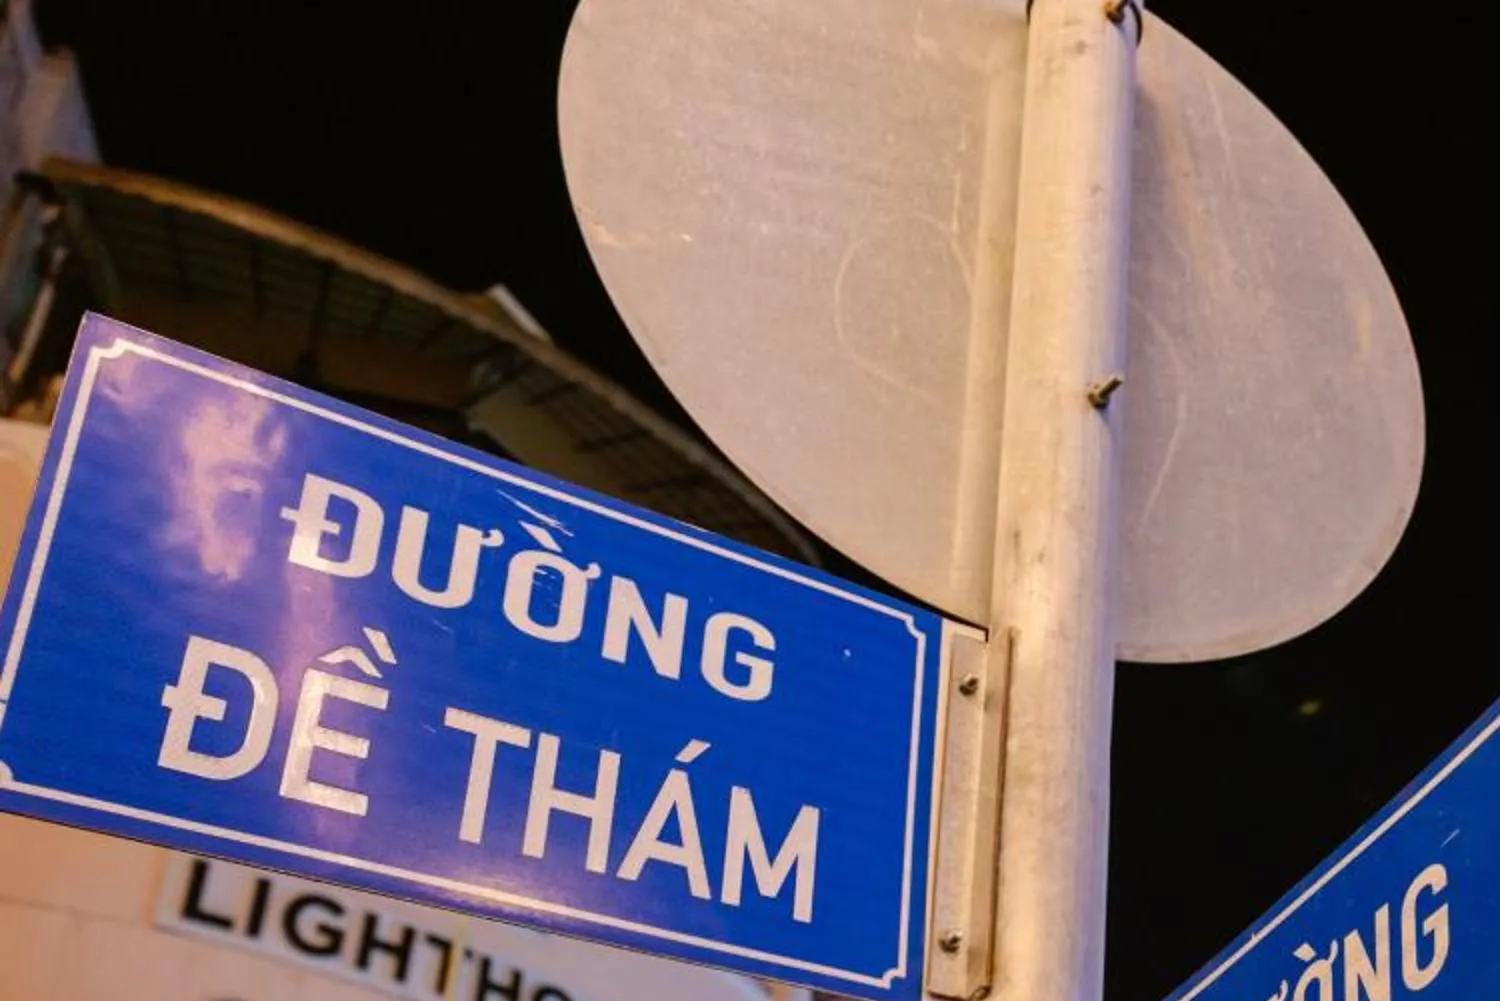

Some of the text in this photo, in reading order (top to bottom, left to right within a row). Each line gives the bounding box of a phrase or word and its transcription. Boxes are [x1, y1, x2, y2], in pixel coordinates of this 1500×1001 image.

[281, 472, 777, 703] ĐƯỜNG
[157, 628, 821, 923] ĐỀ THÁM
